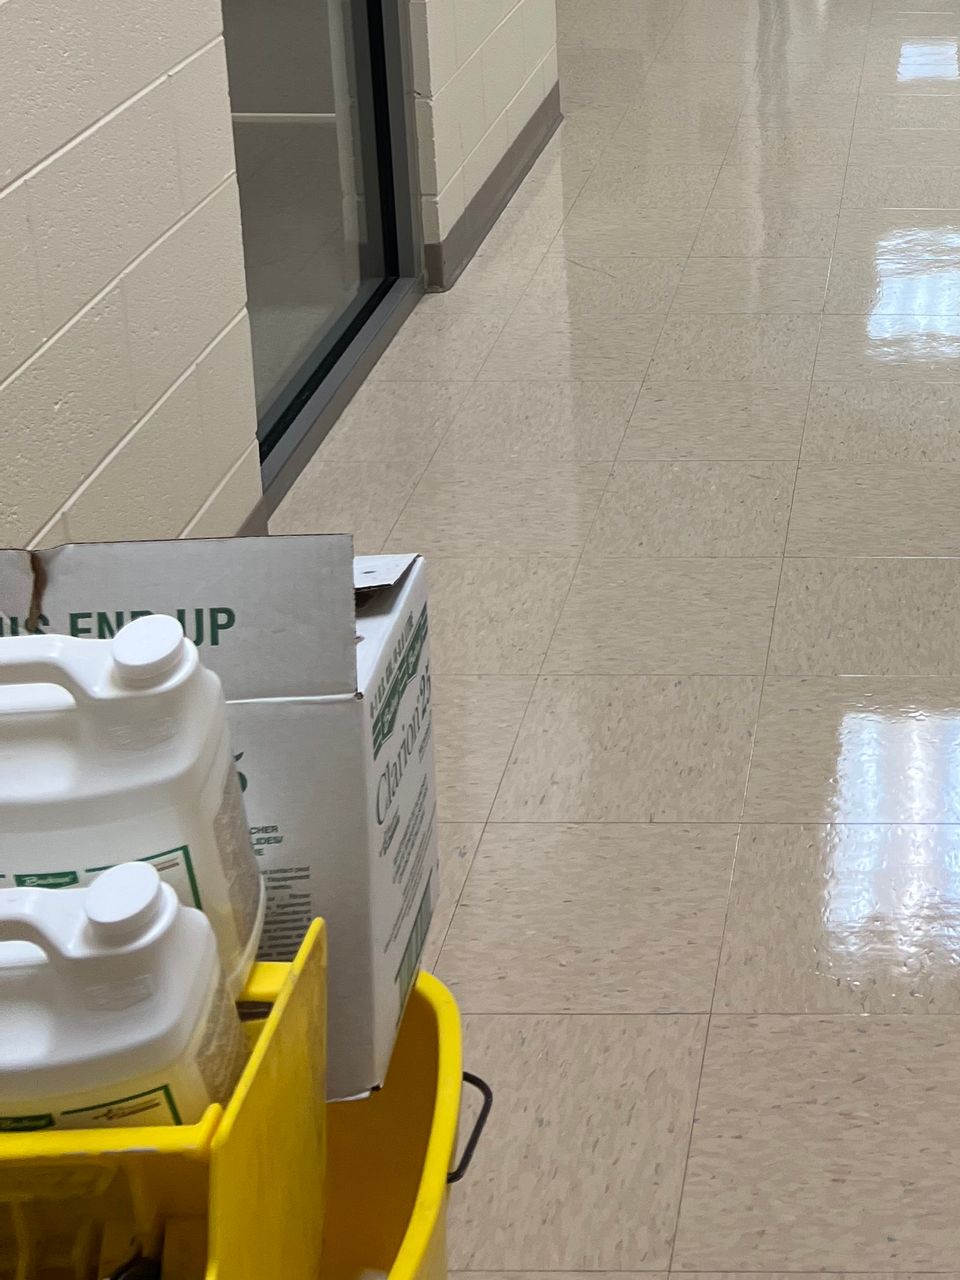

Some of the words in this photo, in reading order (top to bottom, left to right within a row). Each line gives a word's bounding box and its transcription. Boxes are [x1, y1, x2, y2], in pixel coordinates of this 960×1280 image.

[69, 610, 156, 640] EN
[176, 607, 236, 647] UP
[376, 706, 421, 826] Clarion
